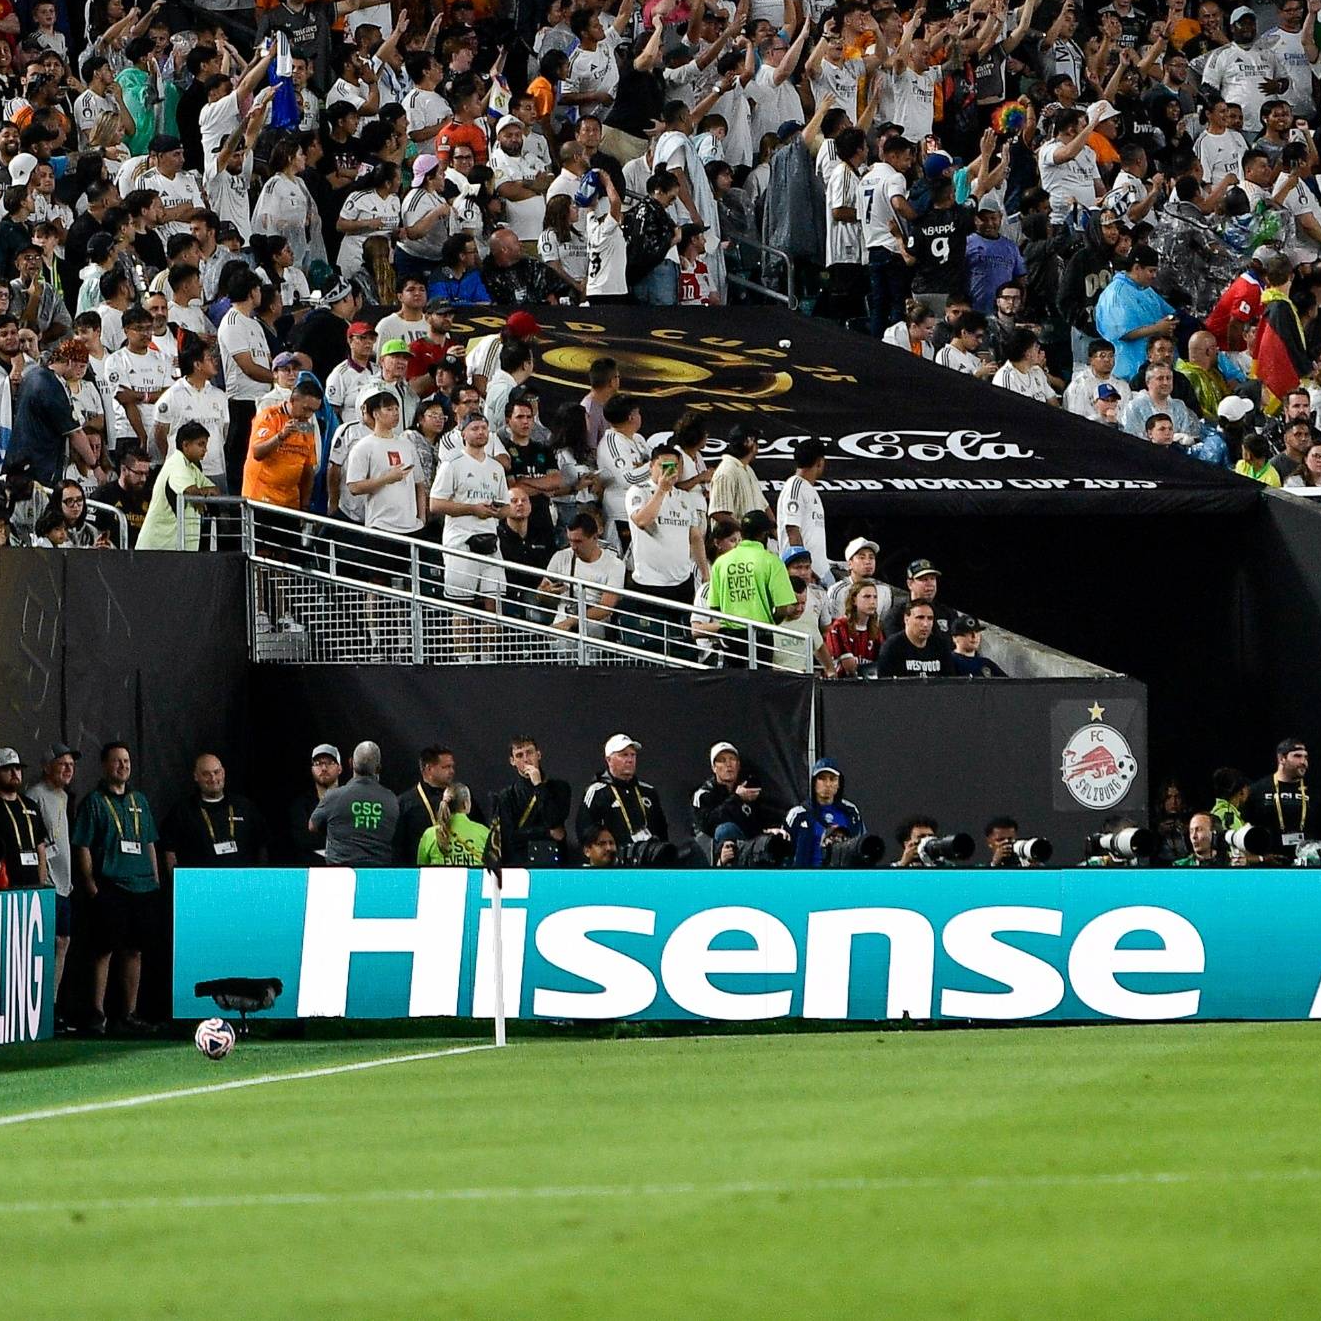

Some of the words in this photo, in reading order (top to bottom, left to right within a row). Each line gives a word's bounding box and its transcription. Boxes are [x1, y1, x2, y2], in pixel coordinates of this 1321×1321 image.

[864, 189, 874, 224] 7
[931, 236, 950, 264] 9
[682, 286, 694, 299] 10
[728, 562, 755, 575] CSC
[730, 589, 757, 603] STAFF
[1091, 730, 1103, 742] FC
[1076, 778, 1122, 802] SALZBURG
[351, 801, 383, 815] CSC
[354, 816, 382, 829] FIT
[296, 867, 1204, 1020] Hisense
